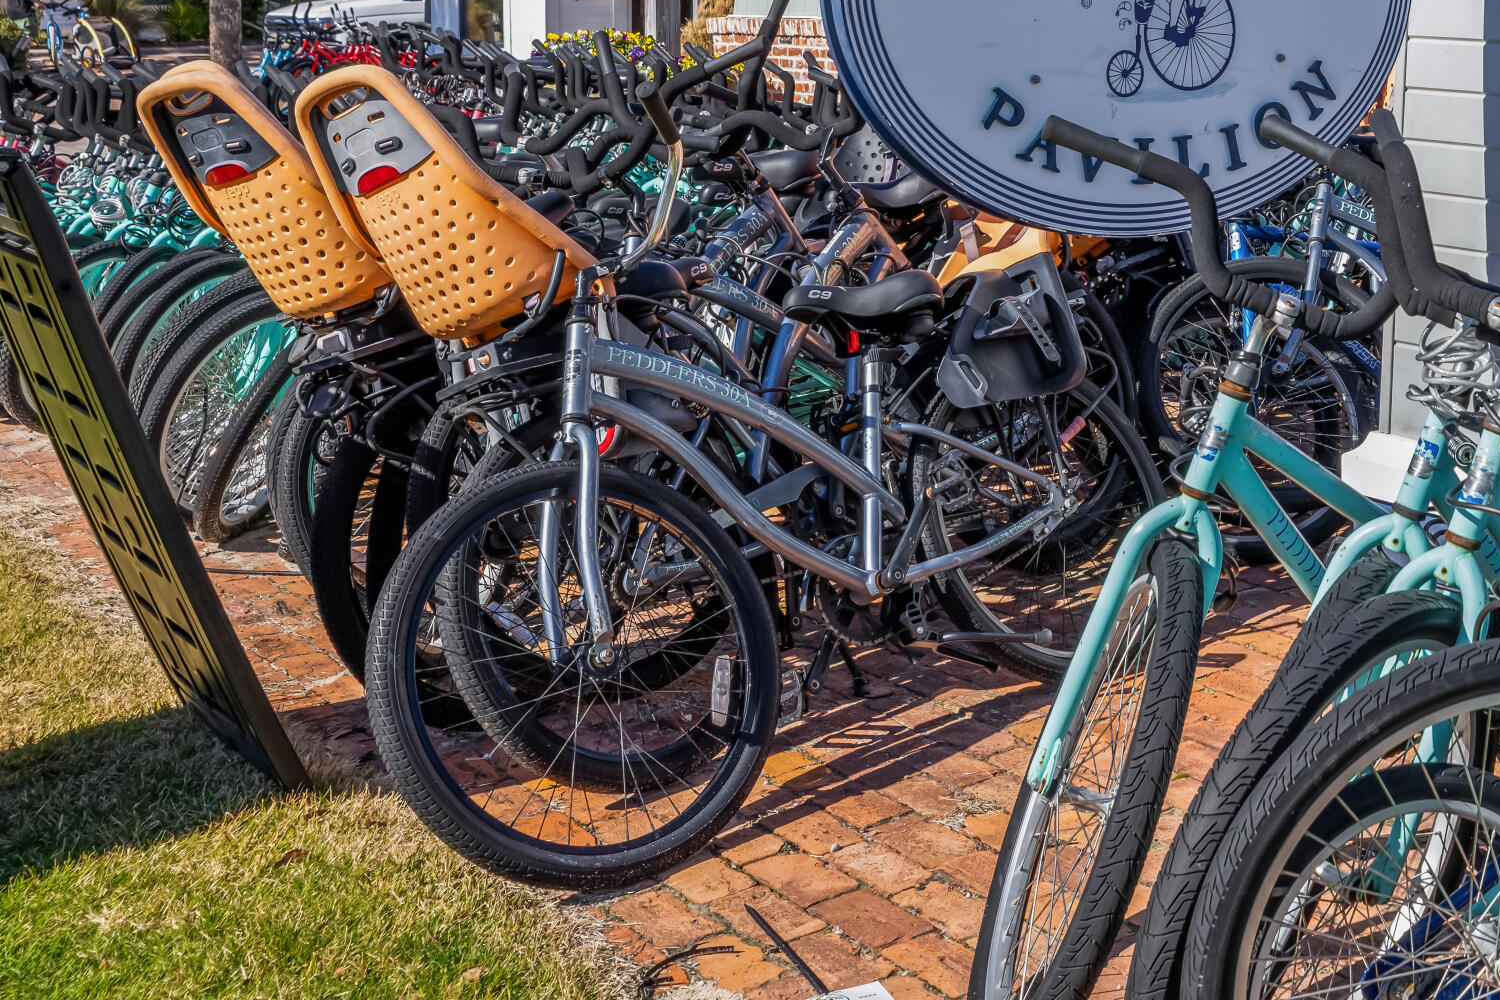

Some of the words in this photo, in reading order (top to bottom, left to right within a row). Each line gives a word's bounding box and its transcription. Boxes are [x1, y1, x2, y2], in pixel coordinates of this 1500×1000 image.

[713, 162, 733, 173] C9
[690, 262, 708, 277] C9
[807, 289, 833, 300] C9
[607, 345, 718, 393] PEDDLERS
[719, 382, 752, 409] 30A
